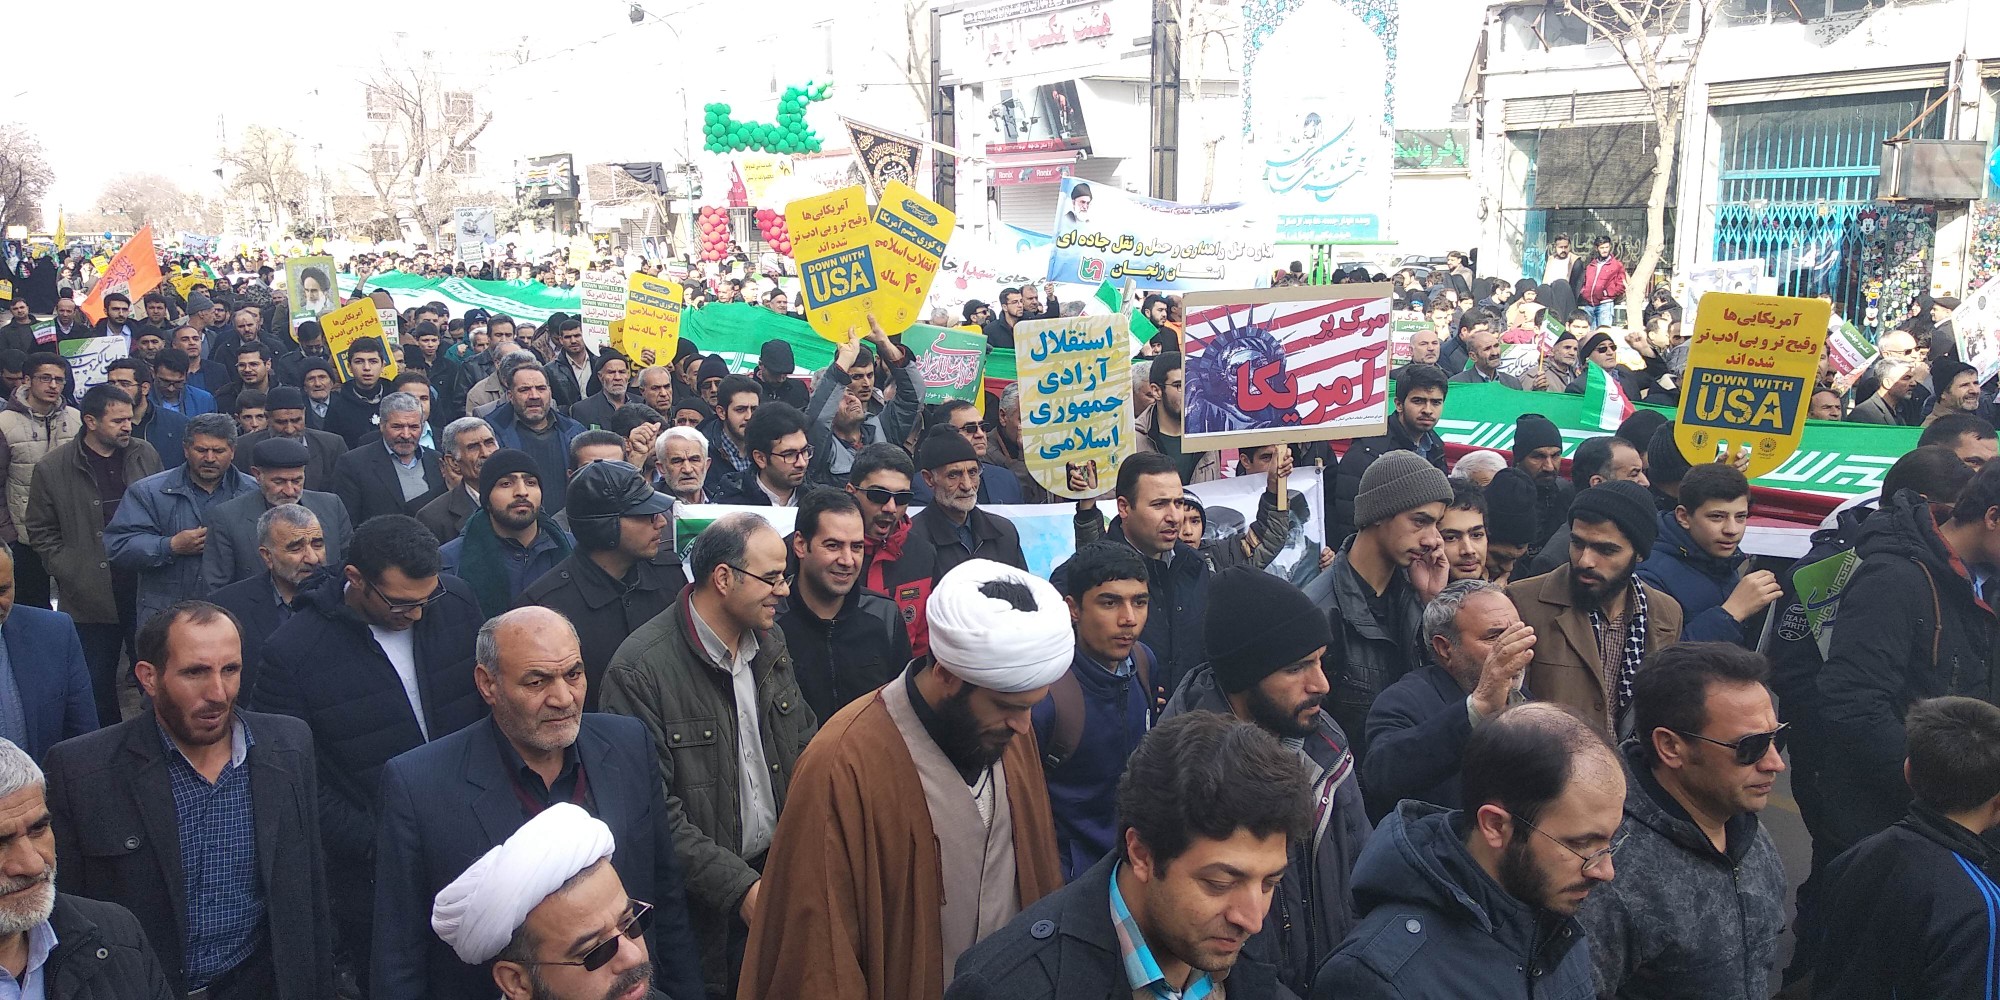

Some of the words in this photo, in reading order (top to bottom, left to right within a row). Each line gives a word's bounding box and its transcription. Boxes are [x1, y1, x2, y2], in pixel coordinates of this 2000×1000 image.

[848, 214, 868, 230] وقیح
[880, 211, 905, 229] آمریکا
[793, 231, 801, 246] تر
[802, 226, 819, 241] ادب
[821, 226, 832, 239] بی
[901, 223, 918, 240] چشم
[1056, 230, 1077, 248] ای
[817, 241, 830, 254] اند
[829, 238, 848, 251] شده
[875, 236, 908, 258] اسلامی
[916, 232, 937, 250] کوری
[1077, 232, 1111, 252] جاده
[1111, 234, 1135, 254] نقل
[1133, 241, 1143, 257] و
[1144, 237, 1171, 258] حمل
[1170, 245, 1180, 258] و
[1227, 241, 1246, 260] کل
[808, 257, 838, 275] DOWN
[839, 250, 866, 264] WITH
[907, 250, 937, 274] انقلاب
[880, 269, 901, 288] ساله
[1110, 260, 1165, 281] زنجان
[1165, 263, 1226, 282] استان
[810, 261, 872, 303] USA
[904, 272, 923, 296] ۴۰
[629, 290, 648, 301] آمریکا
[647, 295, 659, 304] چشم
[629, 307, 656, 319] اسلامی
[658, 300, 675, 310] کوری
[365, 316, 379, 327] وقیح
[656, 310, 678, 324] انقلاب
[1339, 306, 1387, 337] مرگ
[335, 329, 346, 339] ادب
[347, 327, 355, 336] بی
[629, 323, 642, 332] شد
[642, 325, 657, 337] ساله
[659, 325, 673, 339] ۴۰
[1314, 314, 1336, 340] بر
[1030, 325, 1114, 362] استقلال
[1695, 328, 1711, 344] تر
[1712, 331, 1739, 345] ادب
[1739, 335, 1759, 349] بی
[1769, 336, 1786, 351] تر
[1759, 340, 1769, 350] و
[1785, 336, 1818, 355] وقیح
[1725, 353, 1747, 365] اند
[1747, 356, 1775, 369] شده
[1037, 357, 1111, 395] آزادی
[1702, 373, 1748, 387] DOWN
[1753, 377, 1794, 392] WITH
[1236, 346, 1386, 425] آمریکا
[1029, 395, 1124, 425] جمهوری
[1695, 384, 1783, 430] USA
[1040, 425, 1120, 460] اسلامی
[1782, 621, 1807, 632] SPIRIT
[1785, 614, 1807, 625] TEAM
